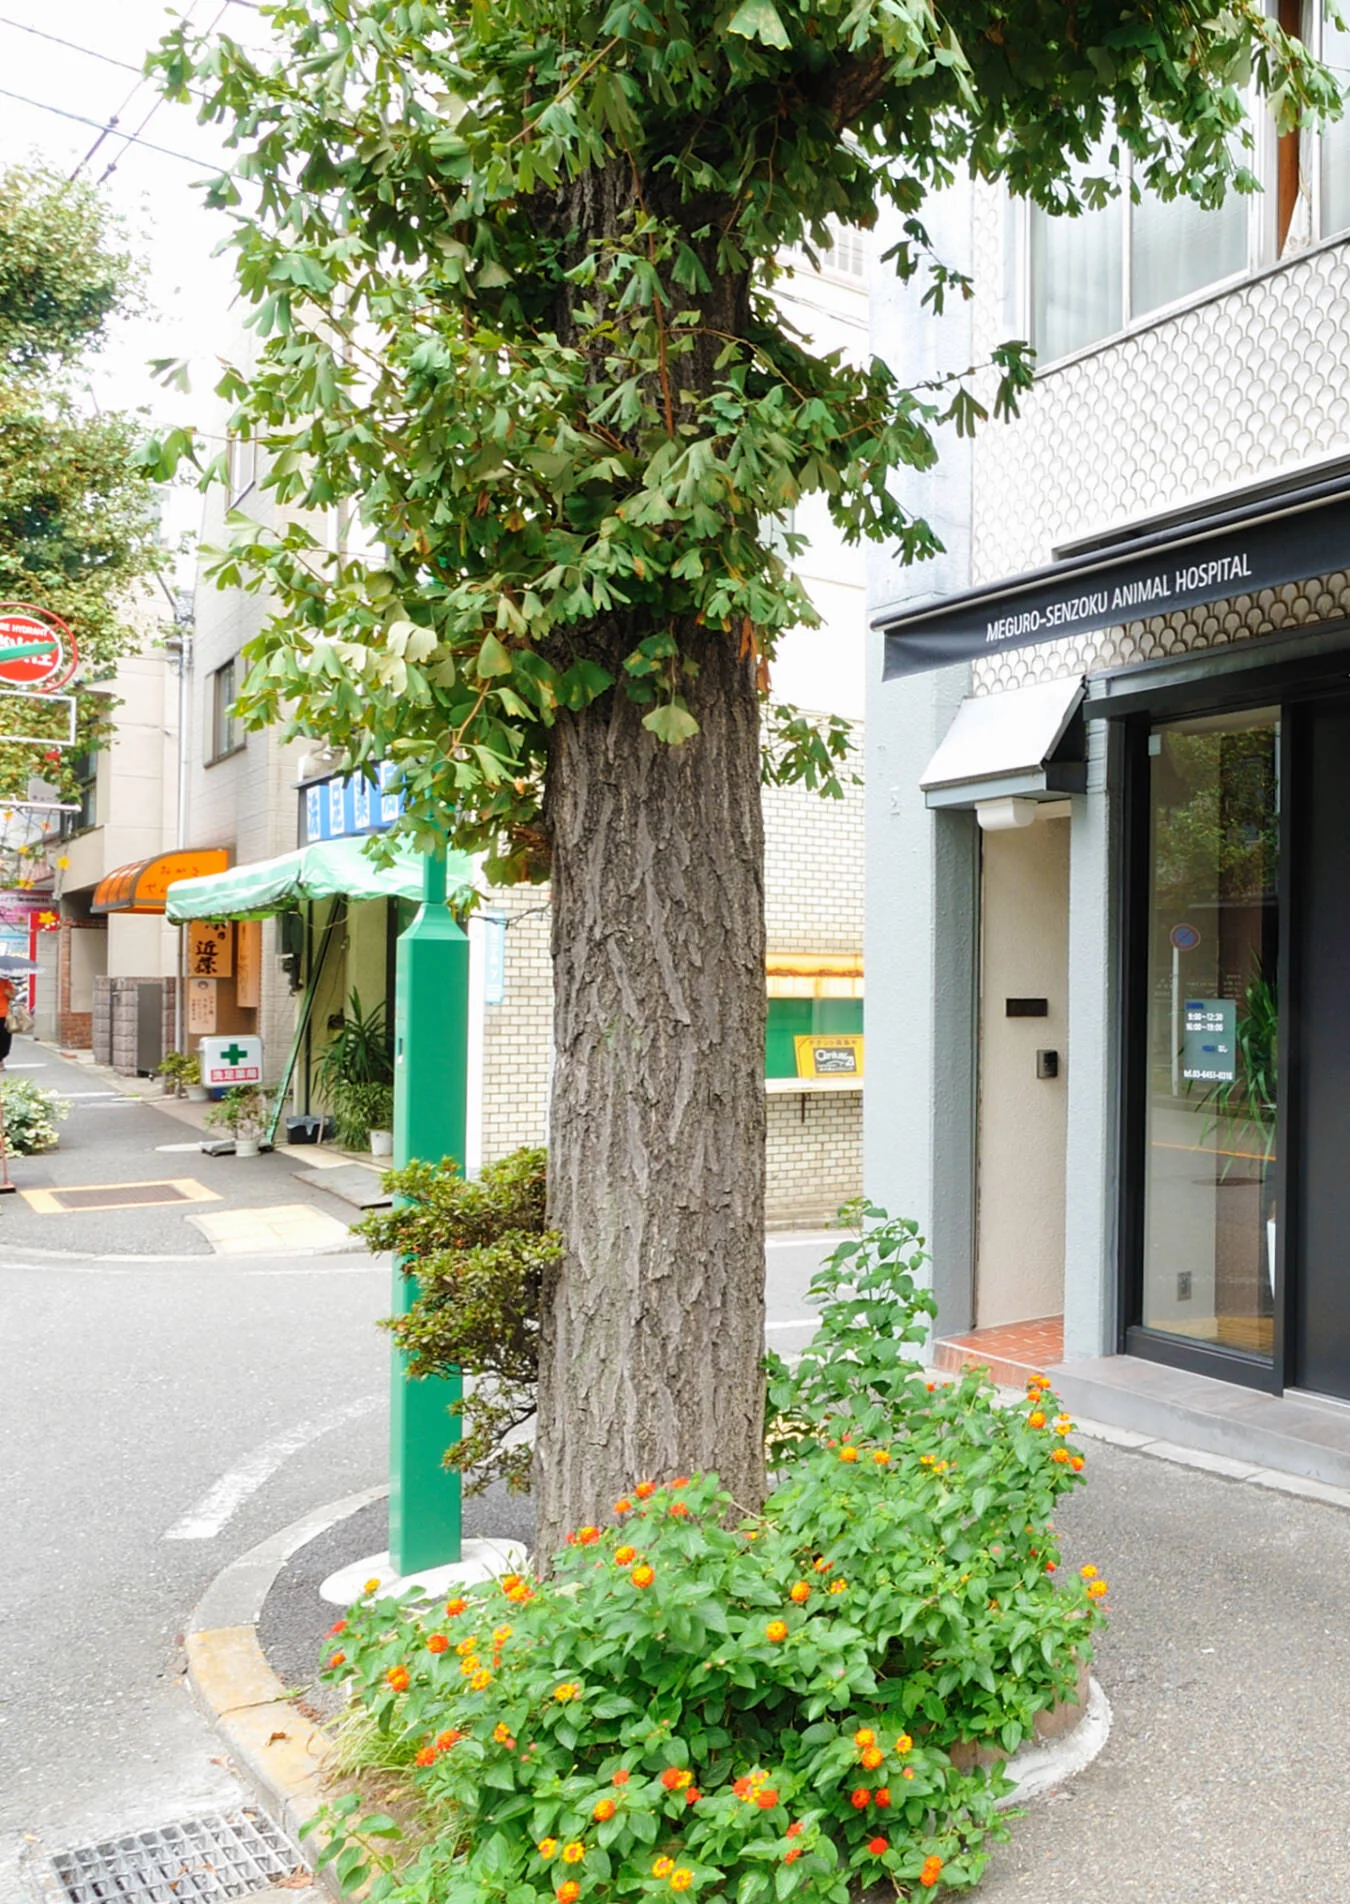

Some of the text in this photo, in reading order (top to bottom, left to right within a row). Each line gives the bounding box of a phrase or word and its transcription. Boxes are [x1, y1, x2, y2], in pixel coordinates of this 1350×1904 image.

[986, 553, 1252, 642] MEGURO-SENZOKU ANIMAL HOSPITAL
